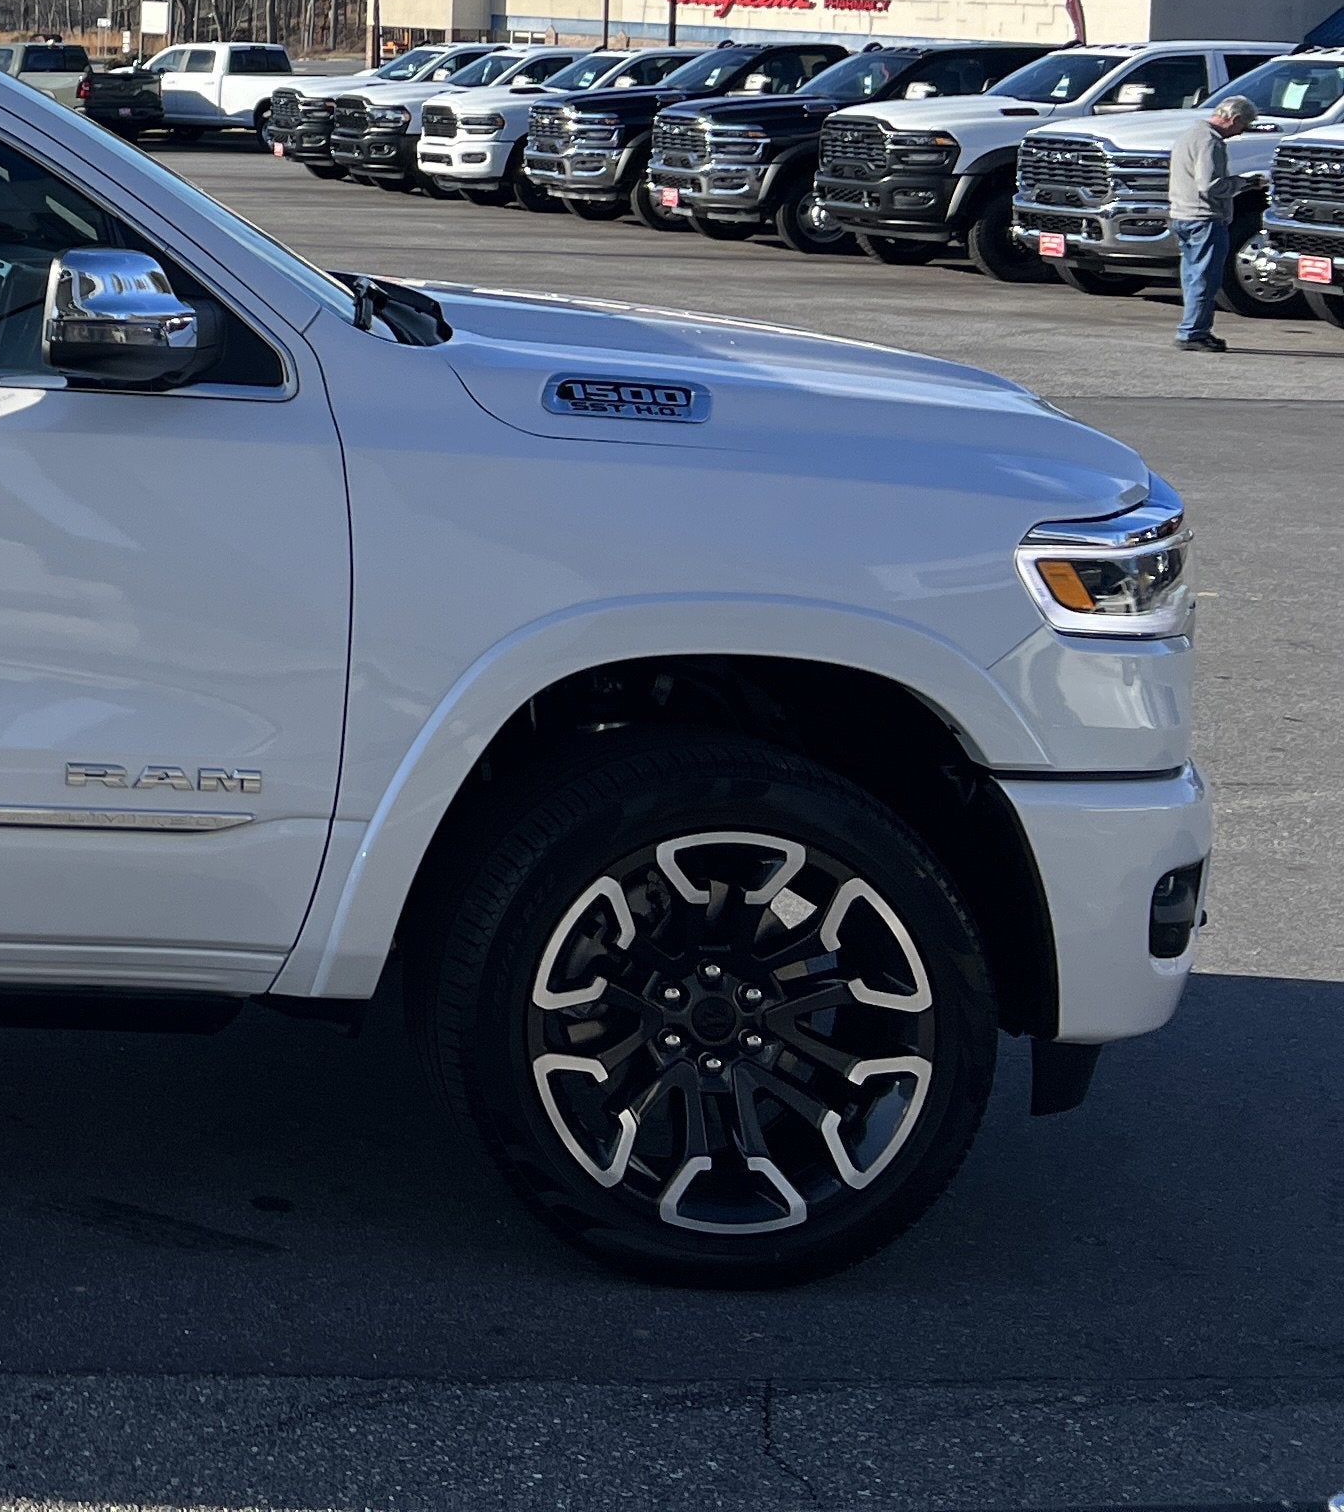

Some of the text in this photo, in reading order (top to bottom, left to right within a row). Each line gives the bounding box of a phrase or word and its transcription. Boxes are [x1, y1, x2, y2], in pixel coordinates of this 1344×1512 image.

[564, 383, 688, 406] 1500
[569, 401, 625, 413] SST
[65, 761, 262, 794] RAM
